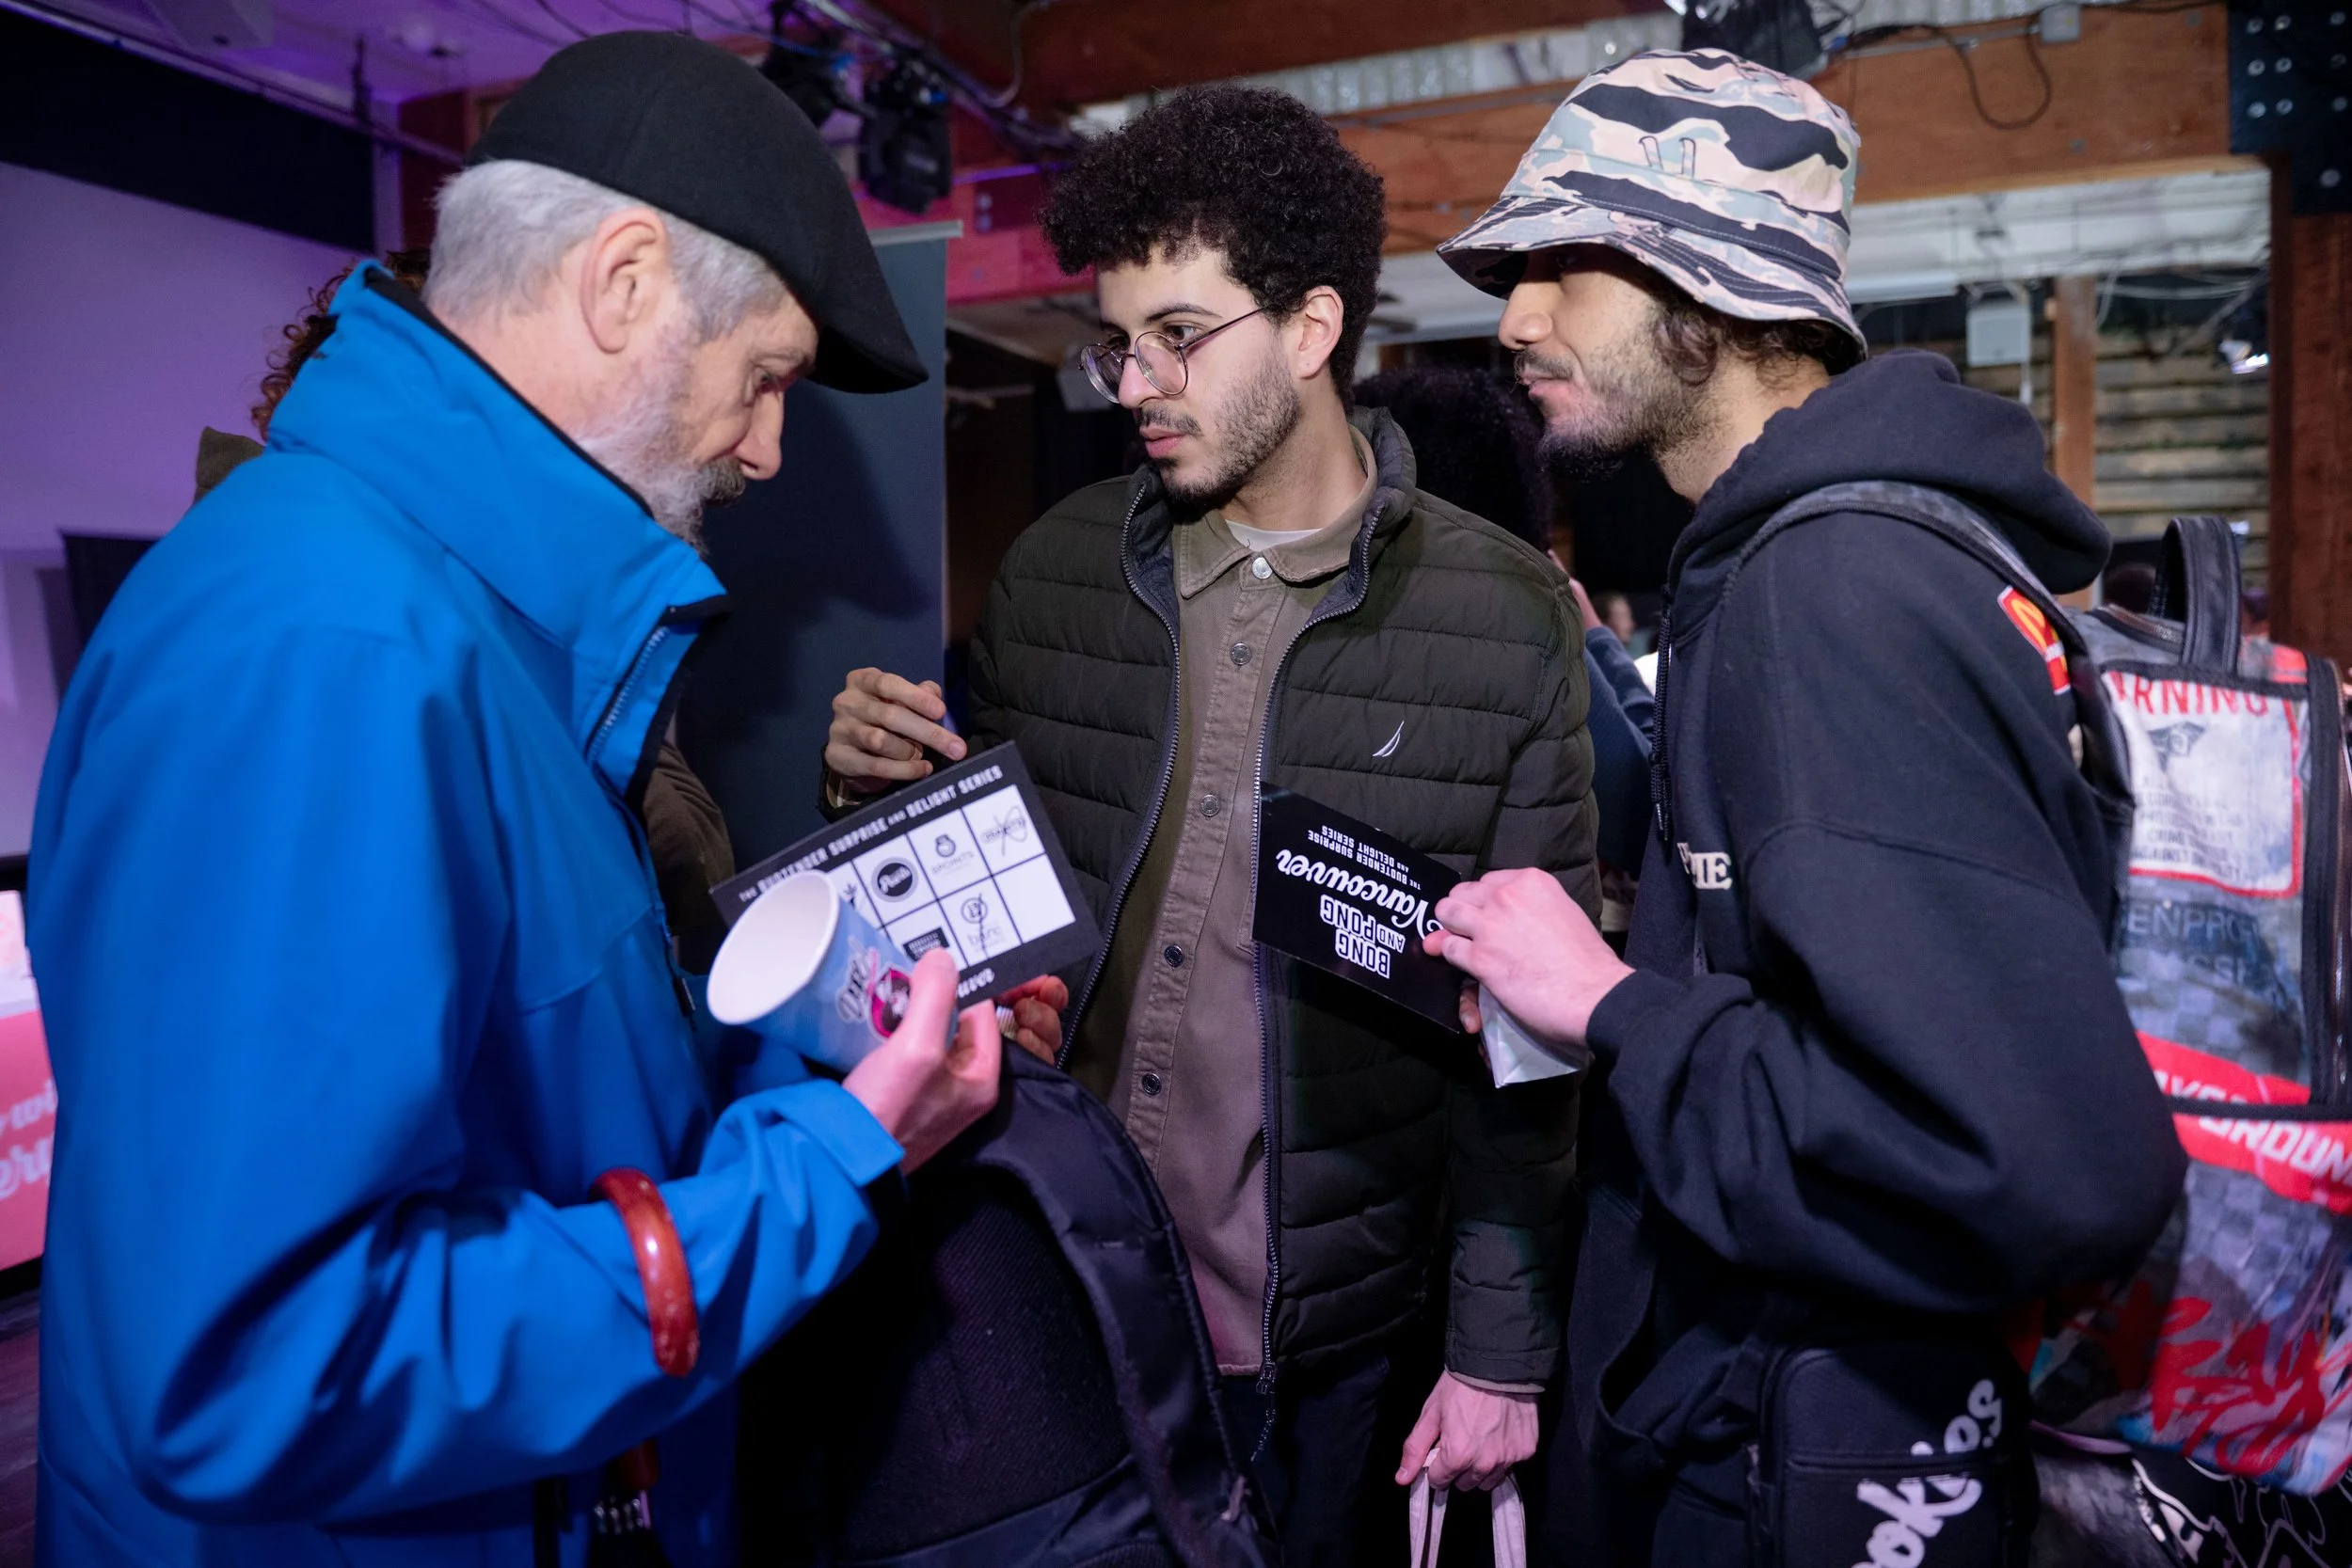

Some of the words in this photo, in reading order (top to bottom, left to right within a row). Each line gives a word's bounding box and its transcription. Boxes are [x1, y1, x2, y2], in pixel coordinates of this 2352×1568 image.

[829, 816, 889, 857] SURPRISE
[906, 784, 959, 818] DELIGHT
[959, 764, 1004, 796] SERIES
[1308, 830, 1354, 859] SURPRISE
[1322, 825, 1355, 849] SERIES
[1357, 852, 1408, 884] BUDTENDER
[1358, 842, 1395, 865] DELIGHT
[1397, 862, 1409, 873] AND
[1275, 848, 1443, 942] Vancouver
[1410, 879, 1422, 890] THE
[1320, 894, 1377, 943] PONG
[1335, 929, 1391, 979] BONG
[1375, 927, 1406, 953] AND
